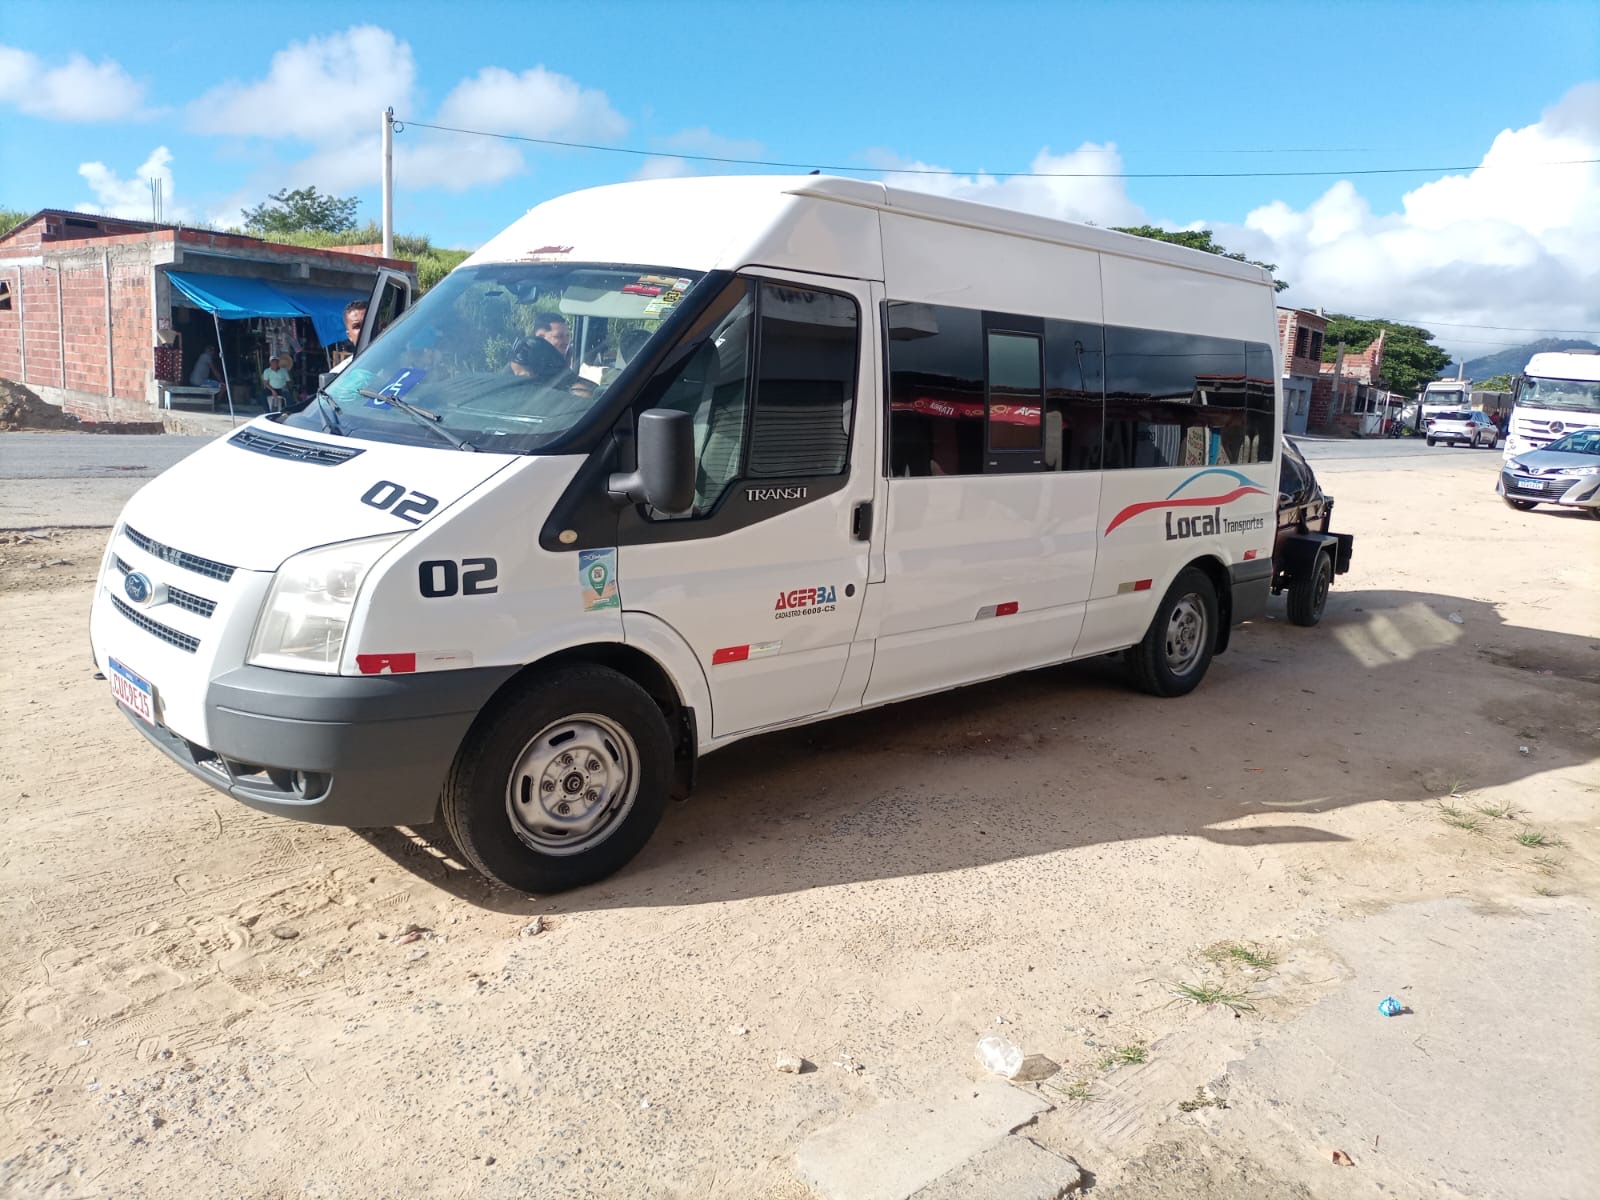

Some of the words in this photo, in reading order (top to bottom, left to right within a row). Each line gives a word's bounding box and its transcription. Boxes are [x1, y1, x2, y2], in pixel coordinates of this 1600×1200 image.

[360, 480, 439, 525] 02
[746, 487, 807, 501] TRANSIT
[1166, 507, 1220, 541] Local
[1223, 518, 1264, 536] Transportes
[419, 558, 498, 598] 02
[775, 585, 836, 610] AGERBA
